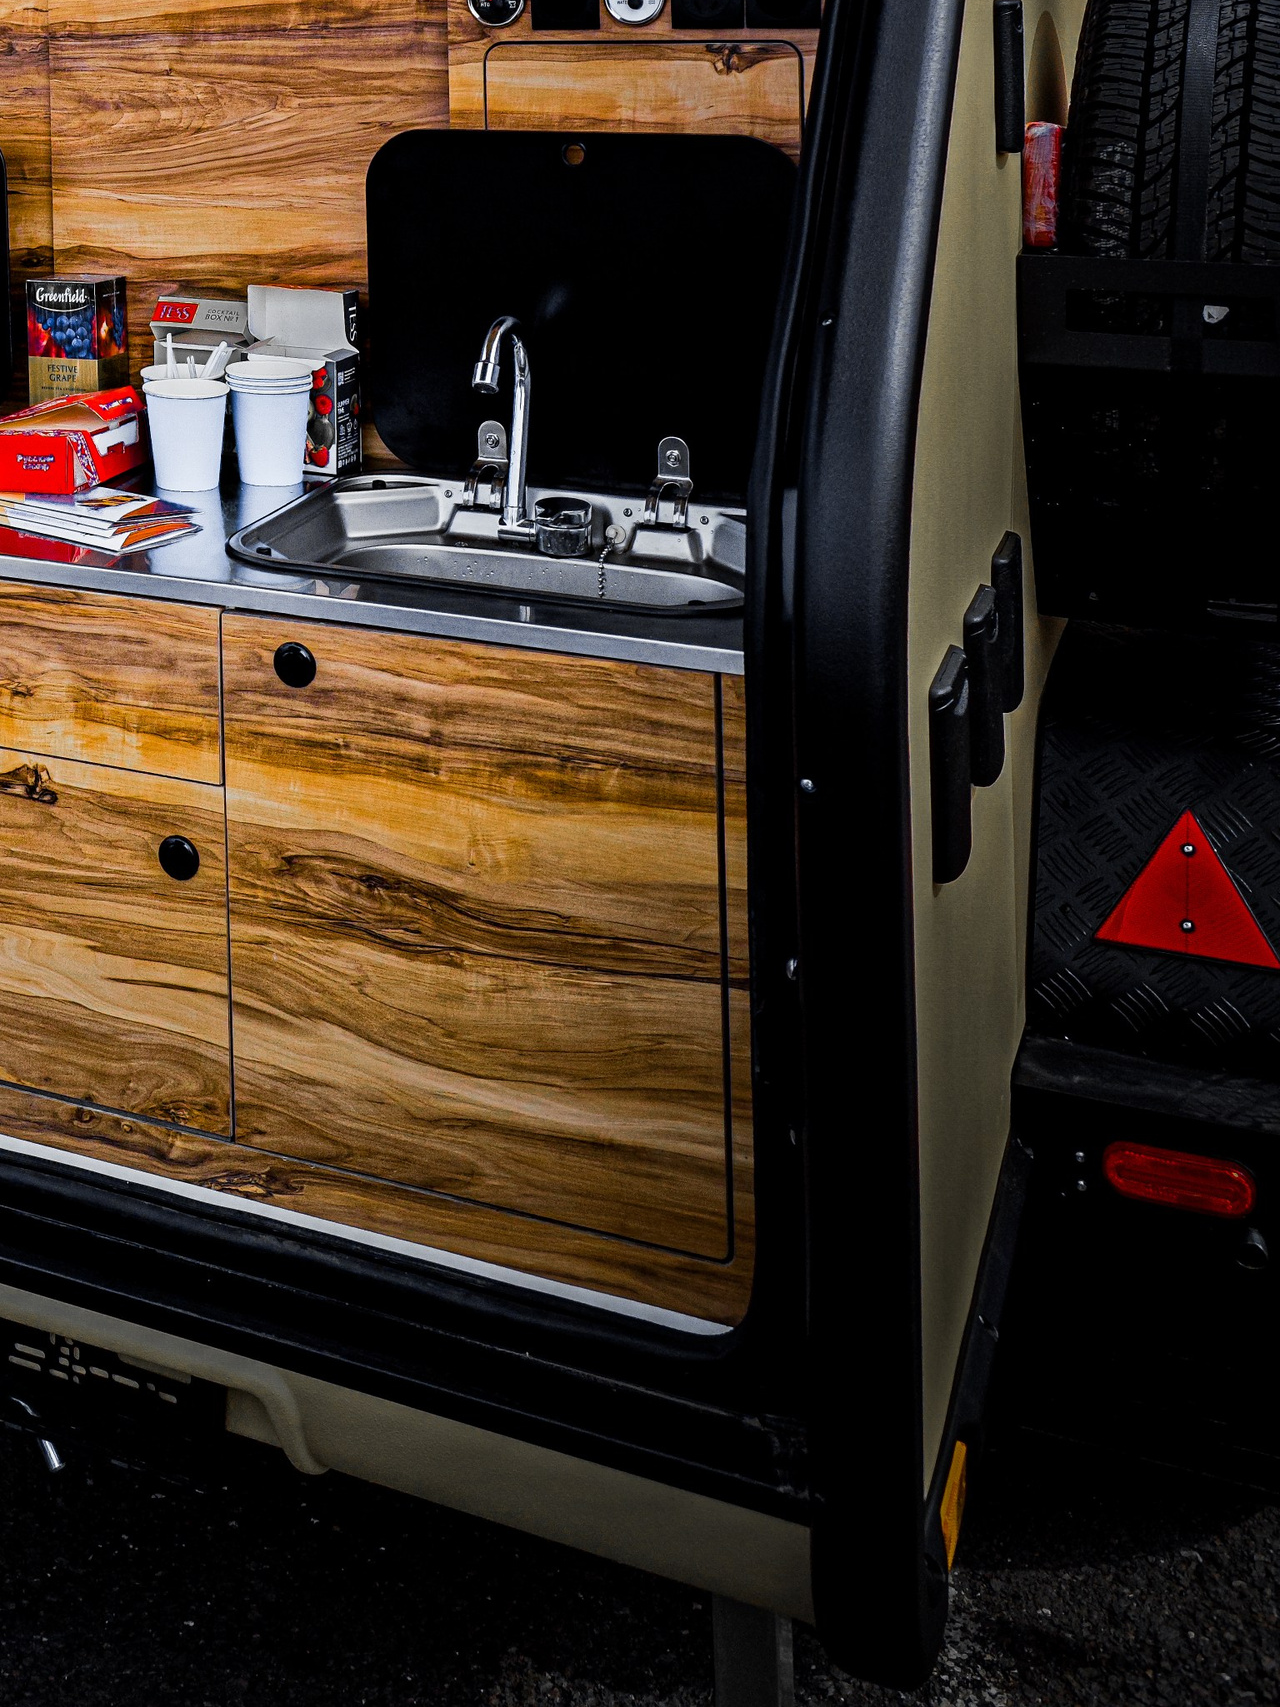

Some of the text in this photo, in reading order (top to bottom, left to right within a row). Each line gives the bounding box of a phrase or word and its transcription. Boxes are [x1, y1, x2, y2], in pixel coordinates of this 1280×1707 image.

[35, 287, 86, 304] Greenfield
[159, 304, 191, 320] TESS
[205, 313, 223, 321] BOX
[207, 308, 240, 316] COCKTAIL
[348, 302, 358, 342] TESS
[47, 364, 78, 373] FESTIVE
[49, 373, 77, 383] GRAPE
